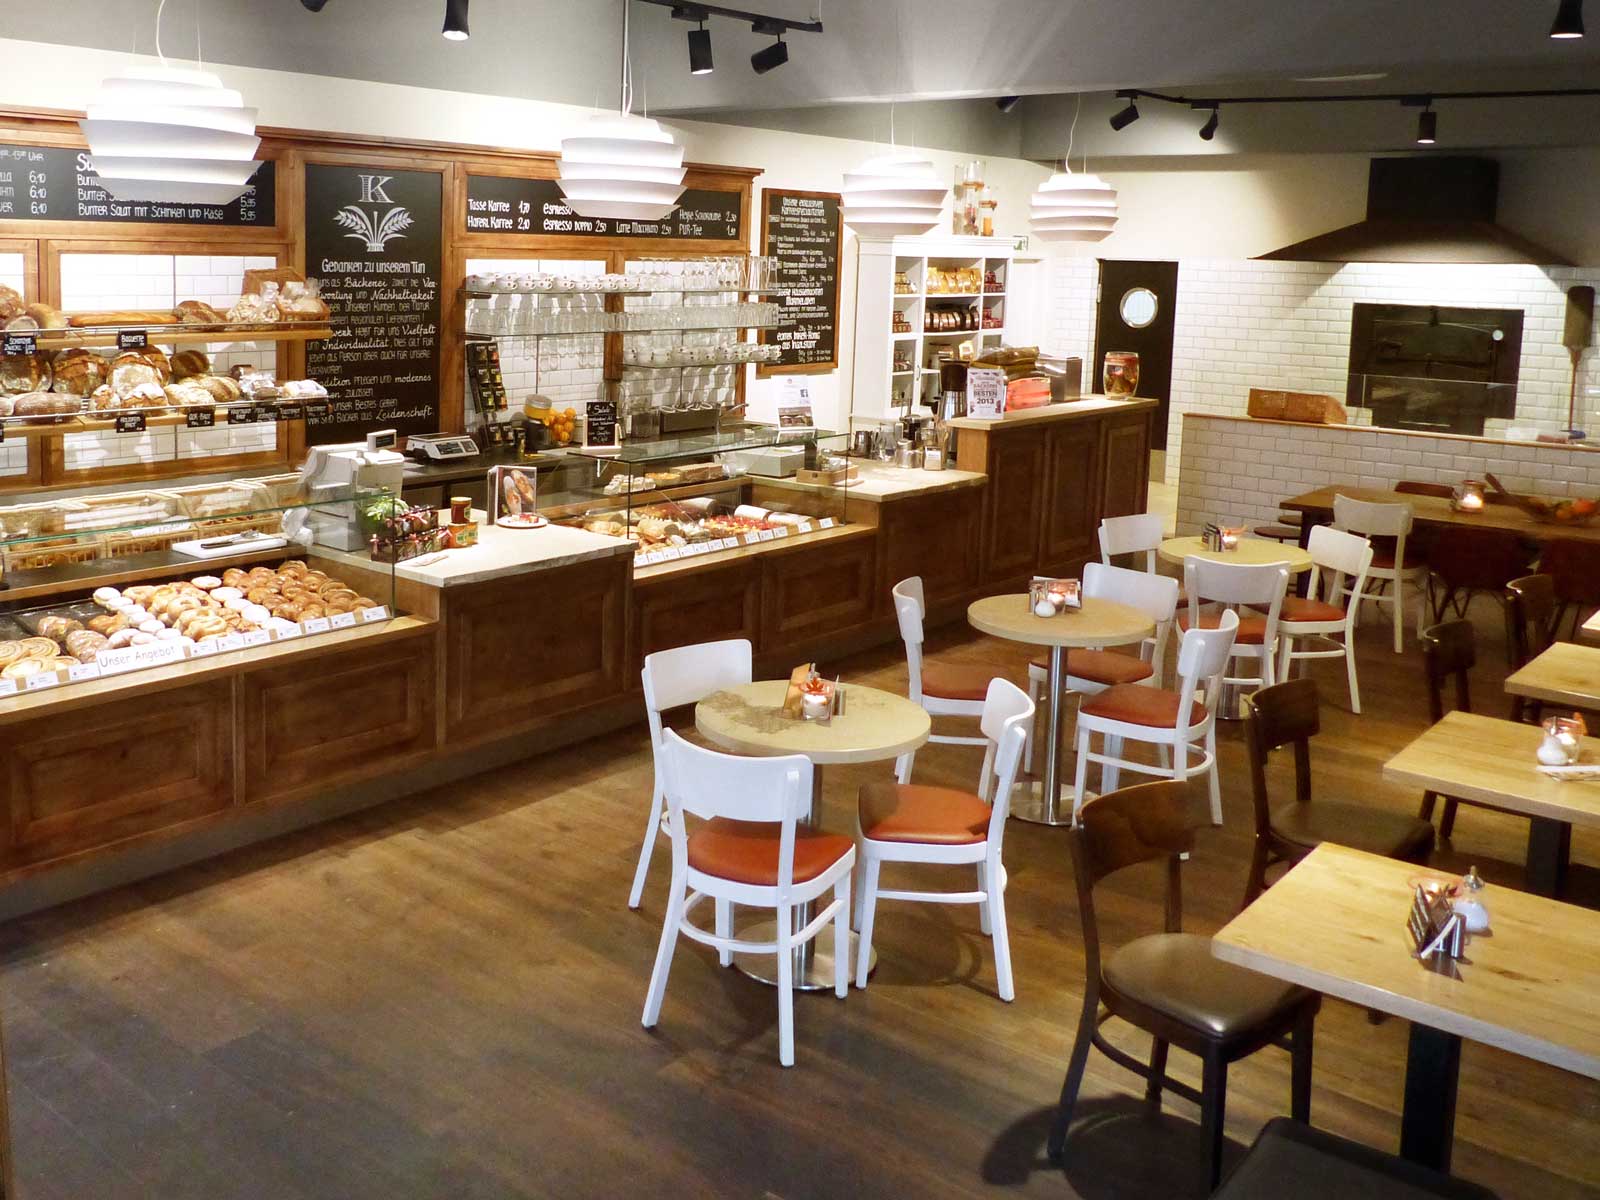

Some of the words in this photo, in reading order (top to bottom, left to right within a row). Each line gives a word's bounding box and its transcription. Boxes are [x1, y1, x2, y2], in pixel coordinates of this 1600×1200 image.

[358, 174, 395, 203] K
[467, 199, 487, 211] Tasse
[488, 200, 511, 213] Kaffee
[490, 216, 513, 229] Kaffee
[364, 262, 375, 273] zu
[411, 261, 426, 273] Tun
[370, 288, 434, 302] Nachhaltigkeit
[402, 324, 437, 337] Vielfalt
[976, 397, 995, 405] 2013
[376, 405, 433, 421] Leidenschaft
[100, 655, 131, 669] Unser
[135, 645, 176, 662] Angebot
